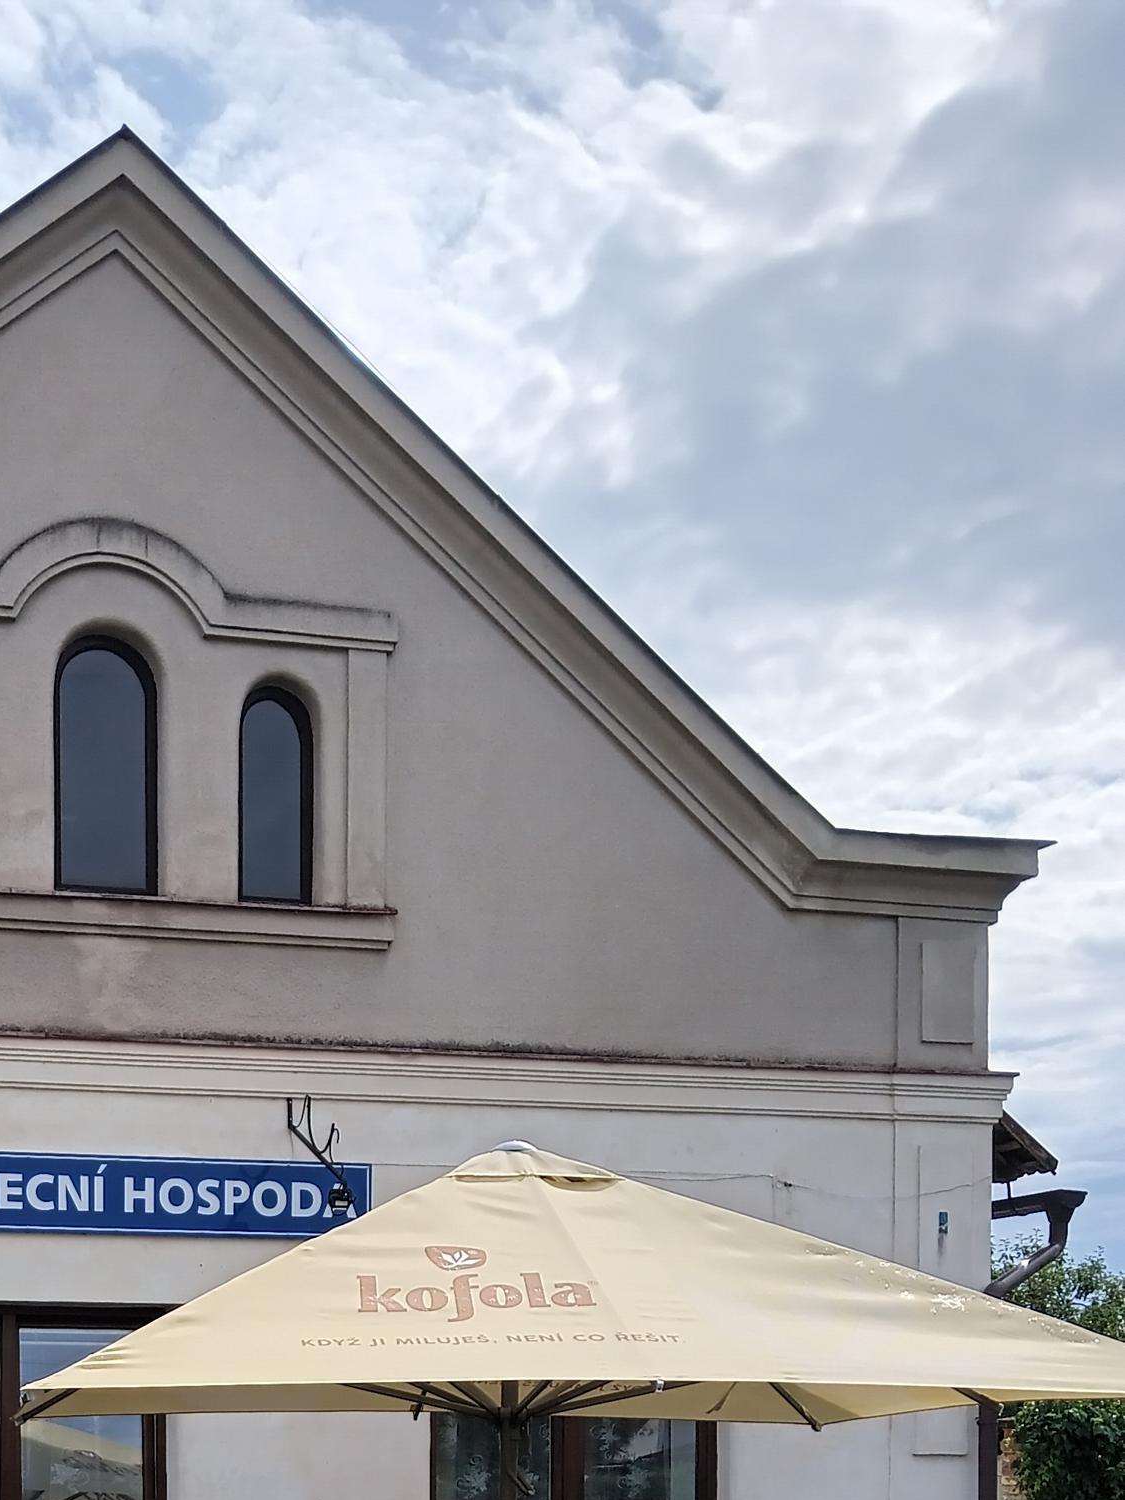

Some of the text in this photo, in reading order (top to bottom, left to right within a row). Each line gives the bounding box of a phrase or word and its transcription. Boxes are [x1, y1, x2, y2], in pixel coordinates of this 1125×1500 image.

[356, 1272, 598, 1323] kofola
[300, 1335, 362, 1347] KDYŽ
[369, 1337, 386, 1348] JI
[506, 1332, 564, 1343] NENÍ
[572, 1333, 605, 1343] CO
